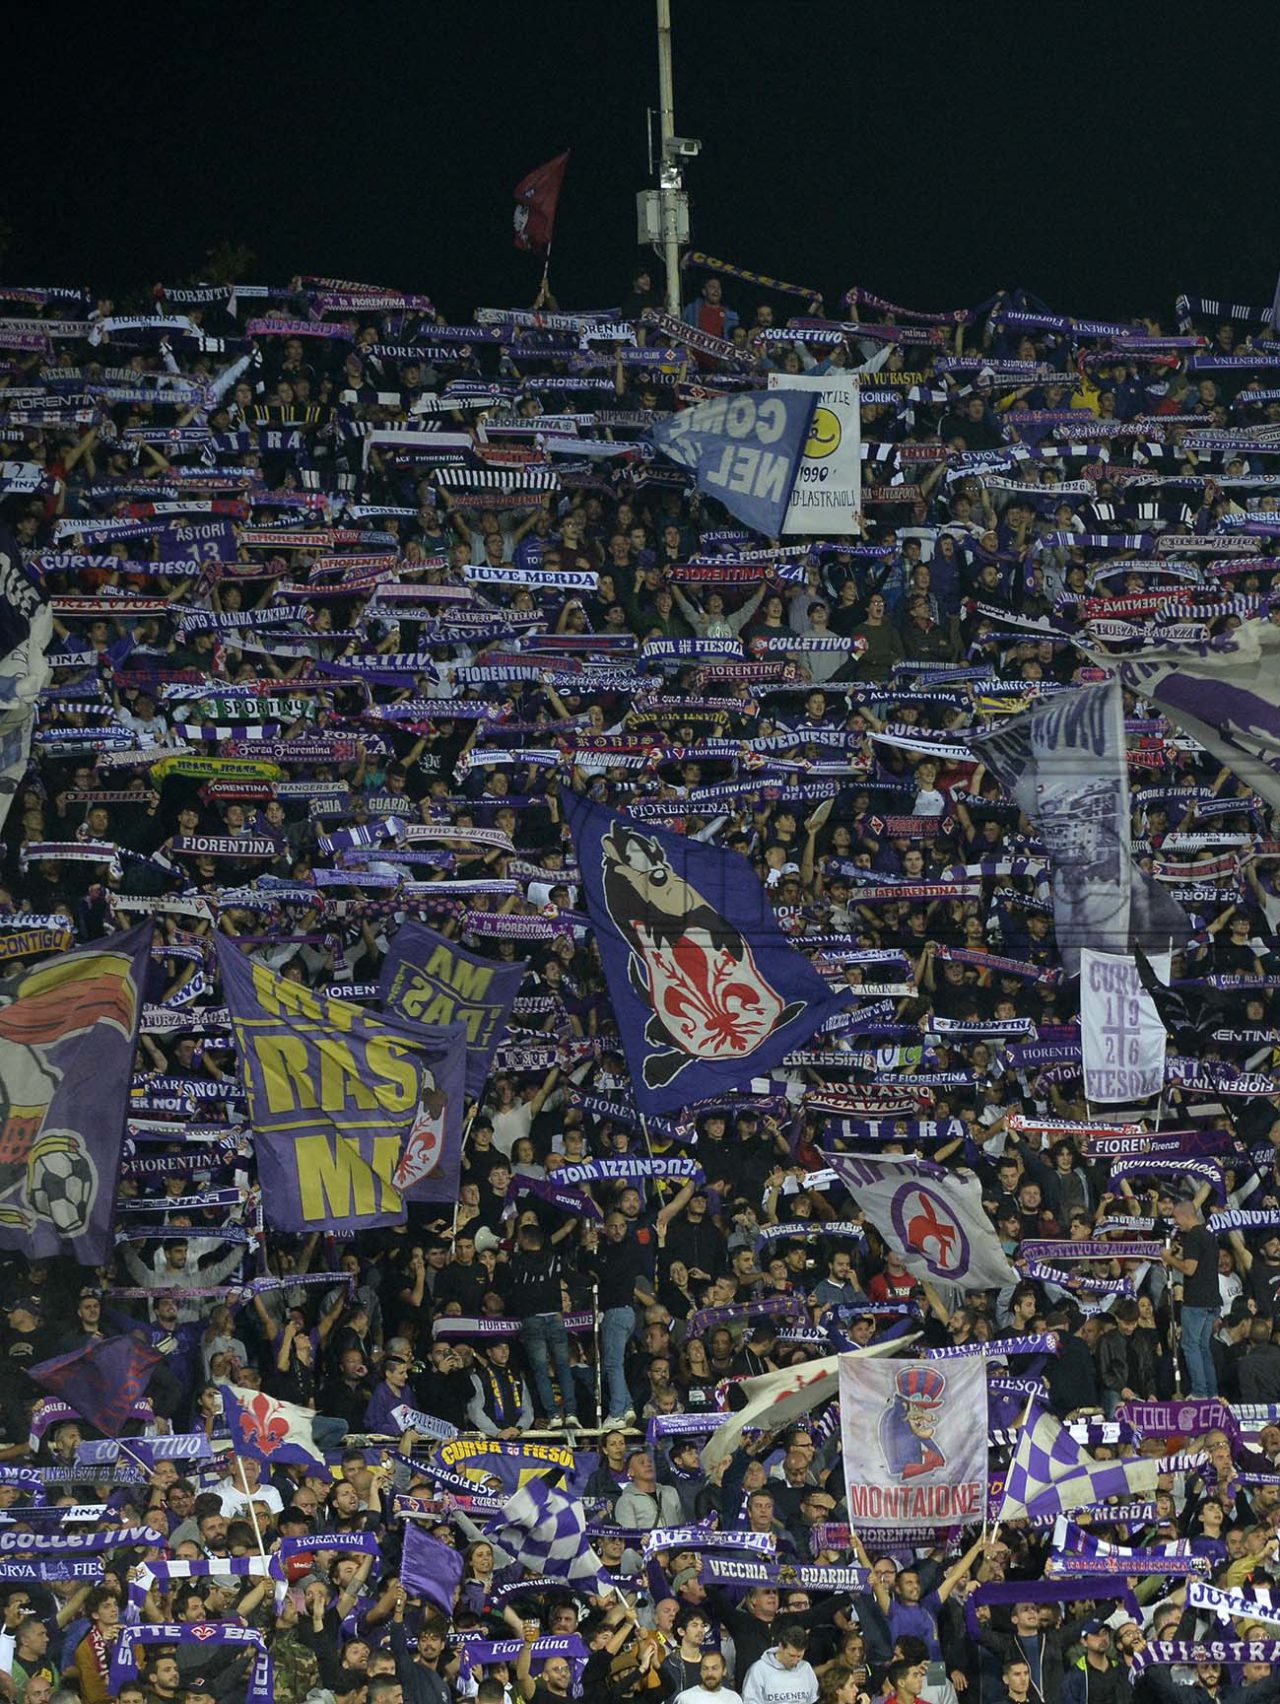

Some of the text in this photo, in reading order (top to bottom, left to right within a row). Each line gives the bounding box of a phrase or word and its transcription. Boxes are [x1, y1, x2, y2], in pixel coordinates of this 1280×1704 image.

[352, 297, 406, 307] FIORENTINA
[420, 325, 483, 337] FIORENTINA
[766, 328, 844, 346] COLLETTIVO
[372, 344, 458, 359] FIORENTINA
[176, 524, 226, 542] ASTORI
[40, 555, 120, 569] CURVA
[467, 568, 520, 582] JUVE
[525, 570, 596, 586] MERDA
[675, 566, 765, 581] FIORENTINA
[768, 637, 851, 652] COLLETTIVO
[458, 666, 540, 682] FIORENTINA
[705, 664, 782, 677] FIORENTINA
[892, 693, 956, 702] FIORENTINA
[575, 734, 655, 747] KORPS
[182, 837, 276, 854] FIORENTINA
[496, 922, 553, 934] FIORENTINA
[1151, 1138, 1181, 1152] Firenze
[130, 1153, 221, 1173] FIORENTINA
[1032, 1261, 1069, 1284] JUVE
[850, 1483, 982, 1521] MONTAIONE
[1094, 1504, 1153, 1522] MERDA
[296, 1534, 364, 1548] FIORENTINA
[709, 1560, 859, 1585] VECCHIA GUARDIA
[491, 1636, 569, 1656] Fiorntina
